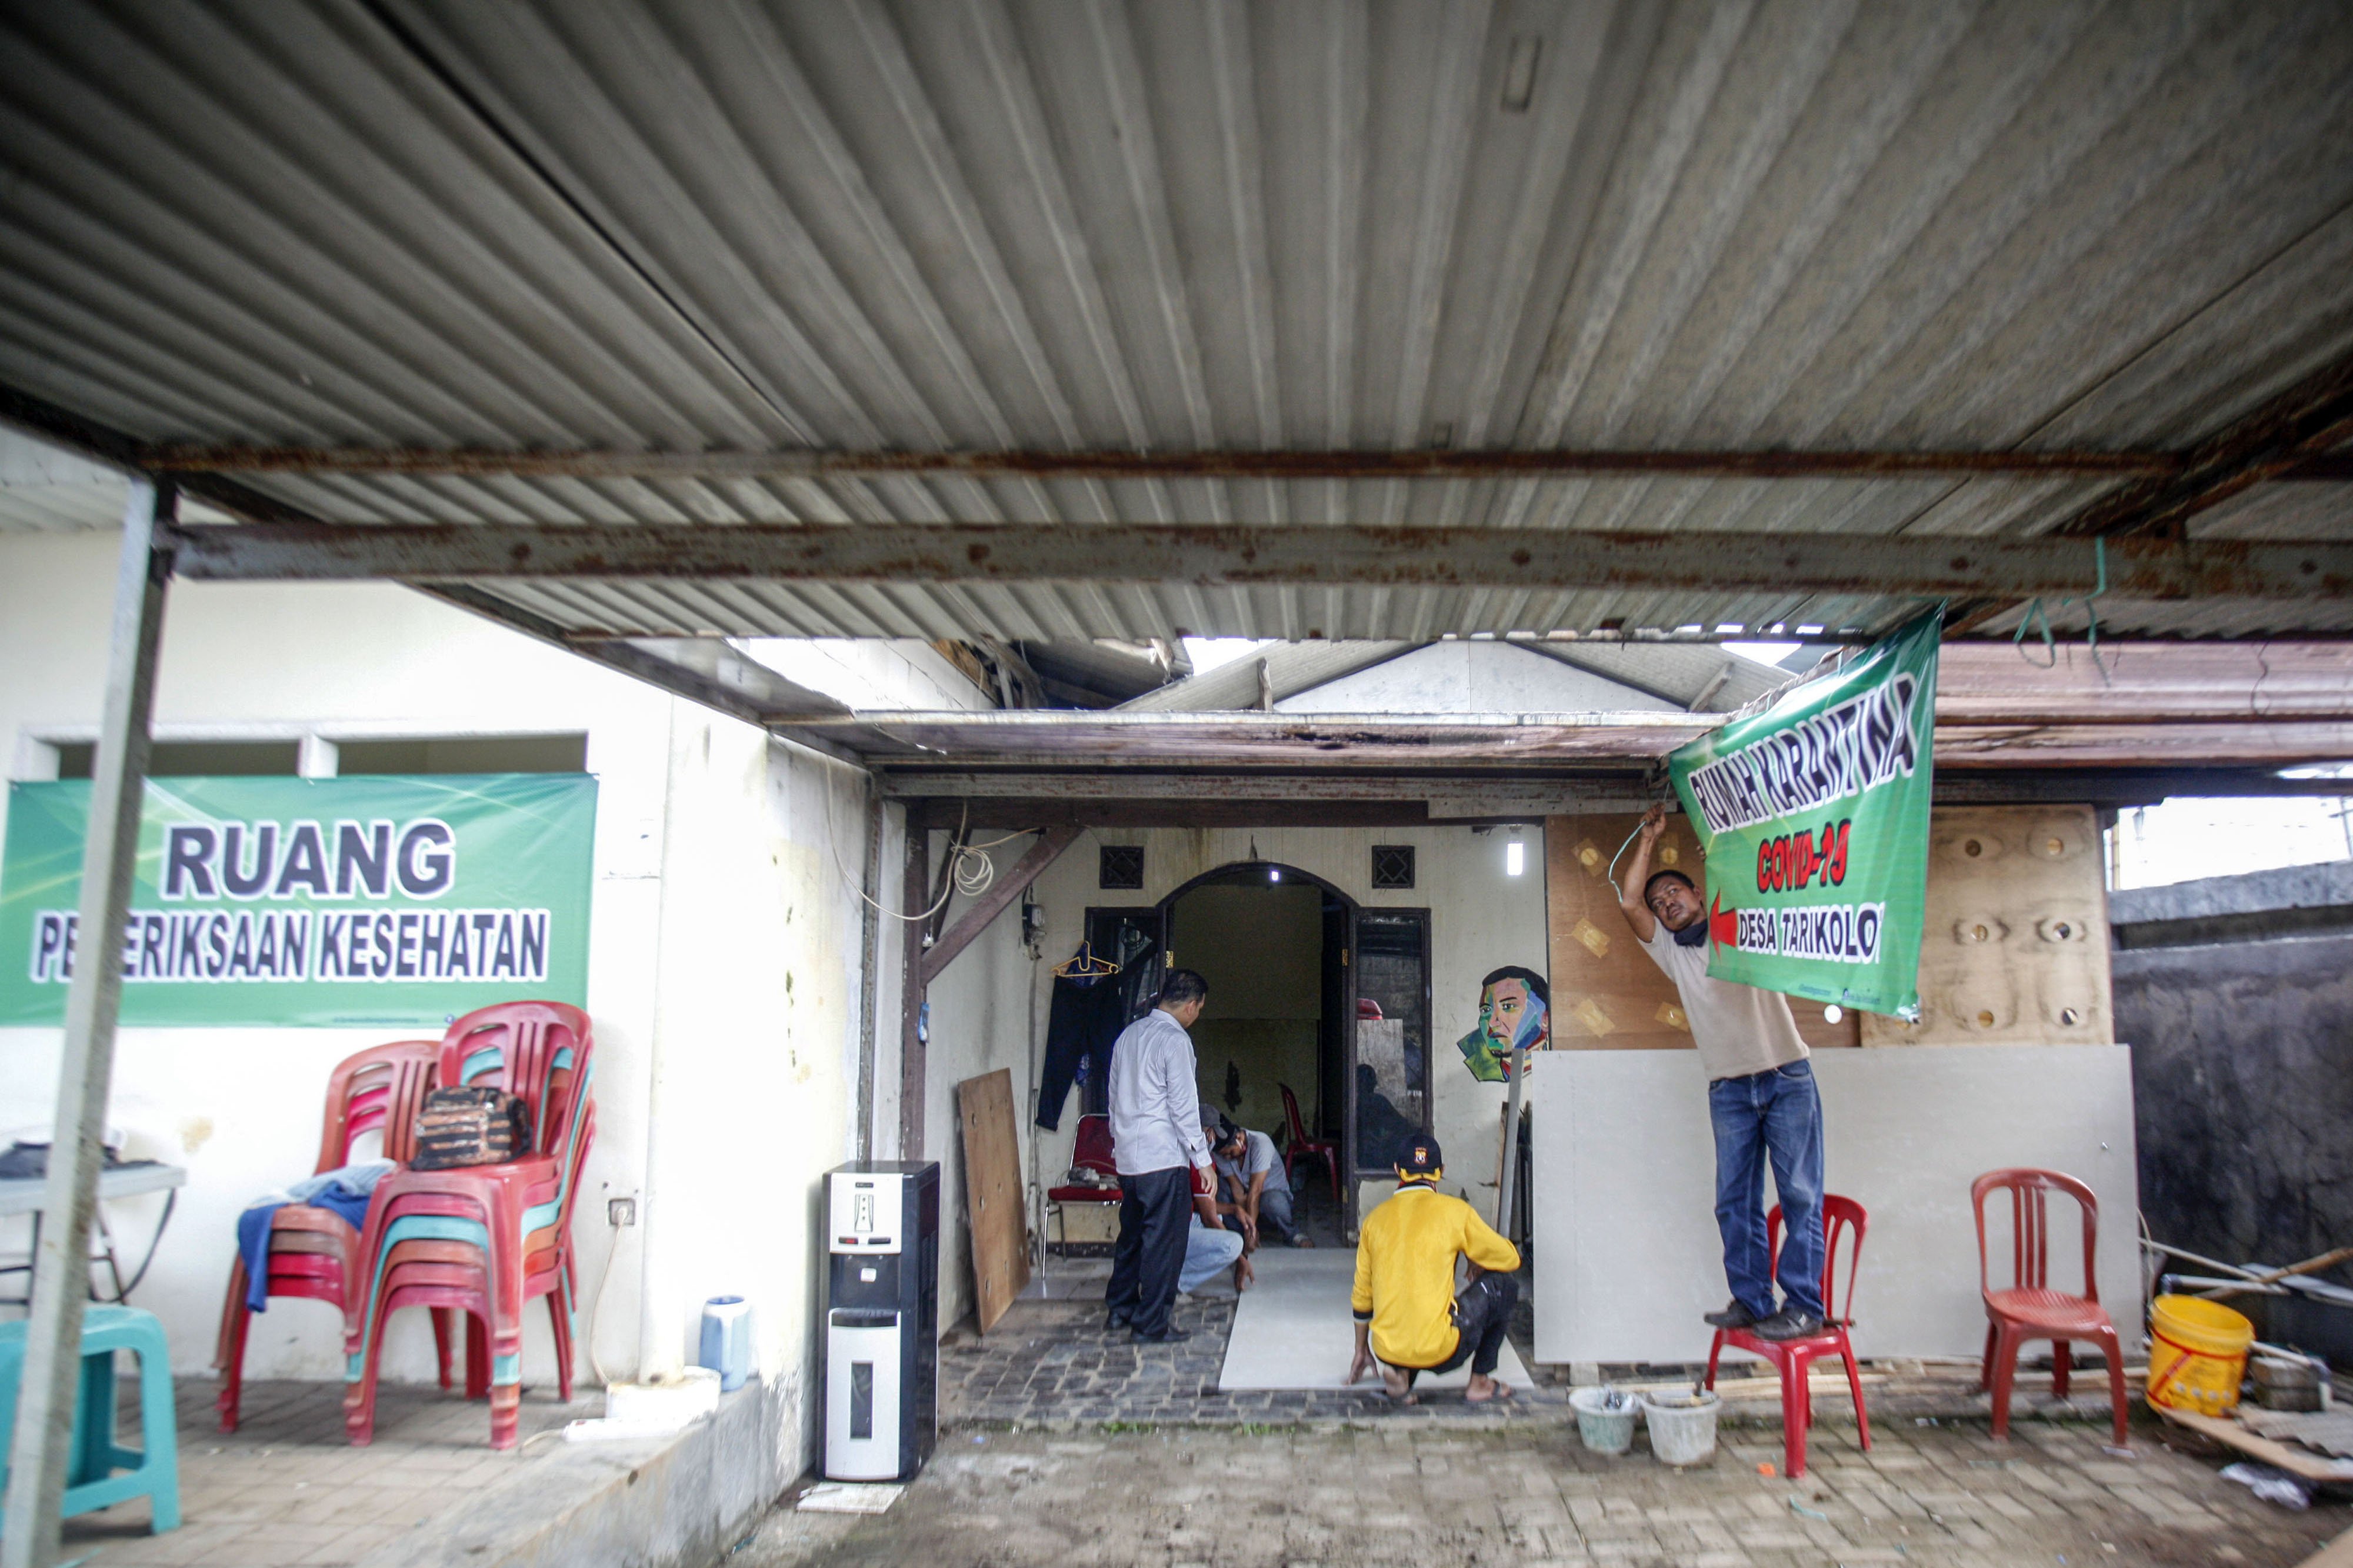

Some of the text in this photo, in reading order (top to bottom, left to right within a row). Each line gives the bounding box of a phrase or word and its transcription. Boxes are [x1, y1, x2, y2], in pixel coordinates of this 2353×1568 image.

[1689, 750, 1771, 833] RUMAH
[161, 819, 454, 900] RUANG
[1758, 819, 1849, 892] COVID-19
[31, 909, 549, 982] PEERIKSAAN KESEHATAN
[1738, 903, 1884, 963] DESA TARIKOLO
